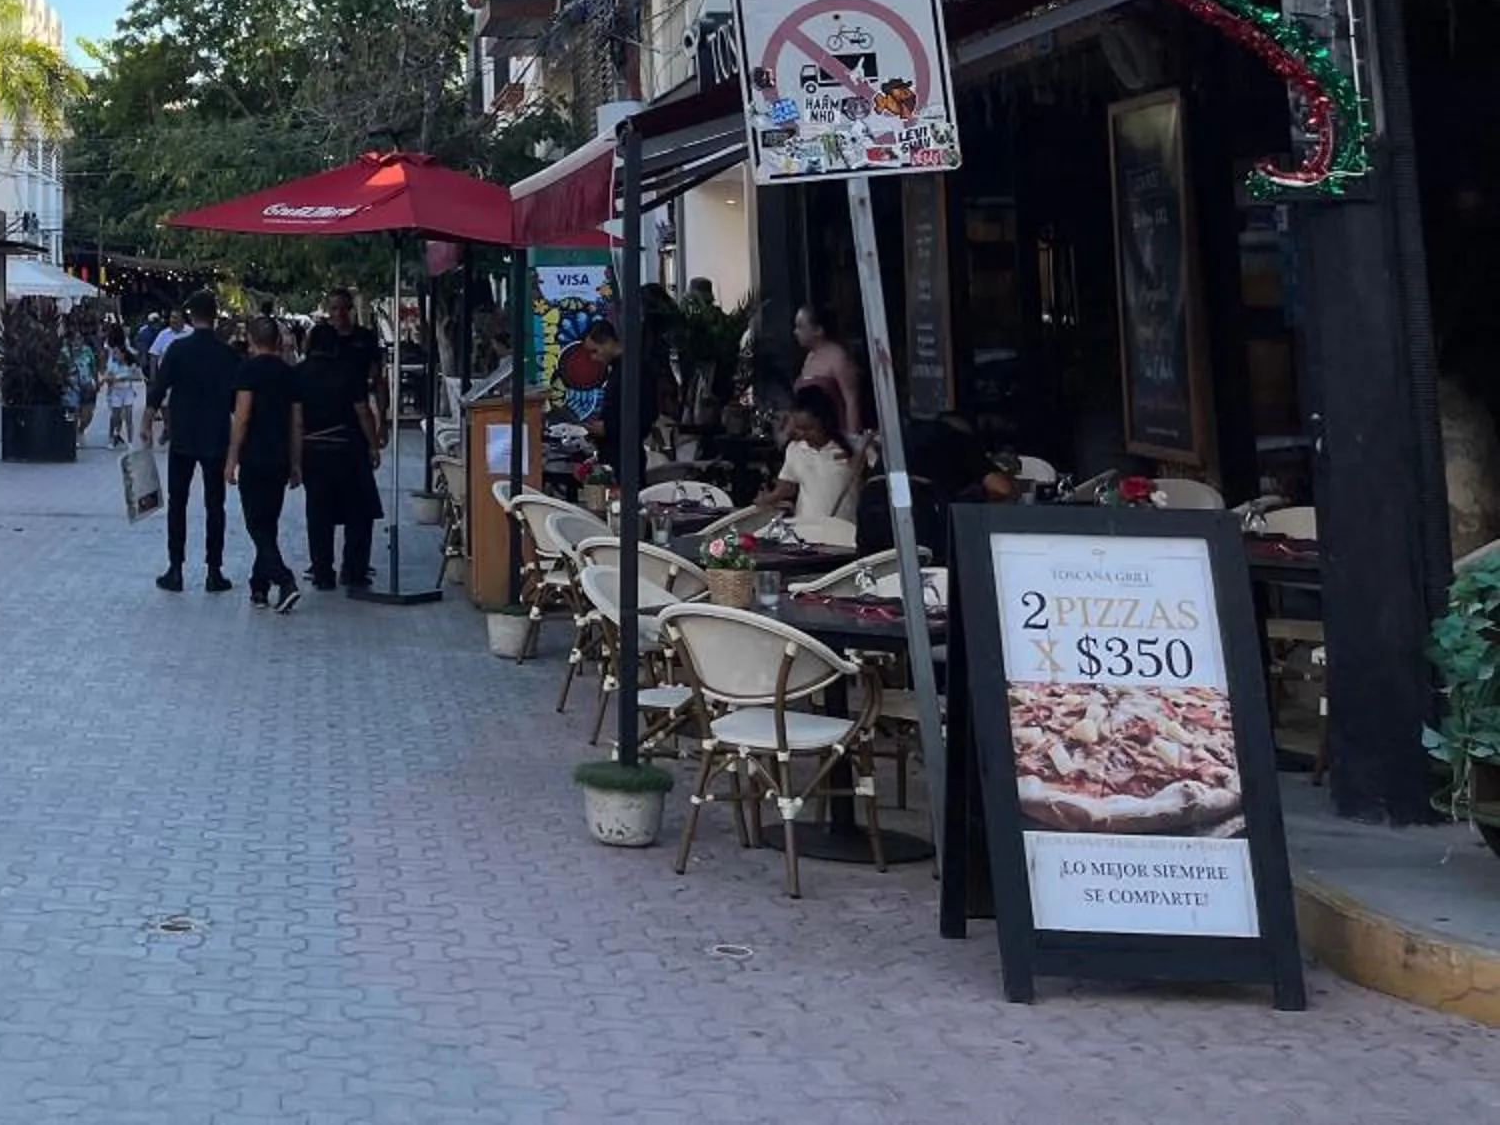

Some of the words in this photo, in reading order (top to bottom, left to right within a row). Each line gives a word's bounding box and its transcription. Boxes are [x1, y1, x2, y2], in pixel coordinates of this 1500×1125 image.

[557, 273, 591, 286] VISA
[1053, 569, 1112, 583] TOSCANA
[1021, 590, 1049, 630] 2
[1054, 596, 1199, 630] PIZZAS
[1076, 633, 1194, 679] $350
[1090, 862, 1150, 880] MEJOR
[1152, 863, 1230, 881] SIEMPRE
[1083, 888, 1103, 904] SE
